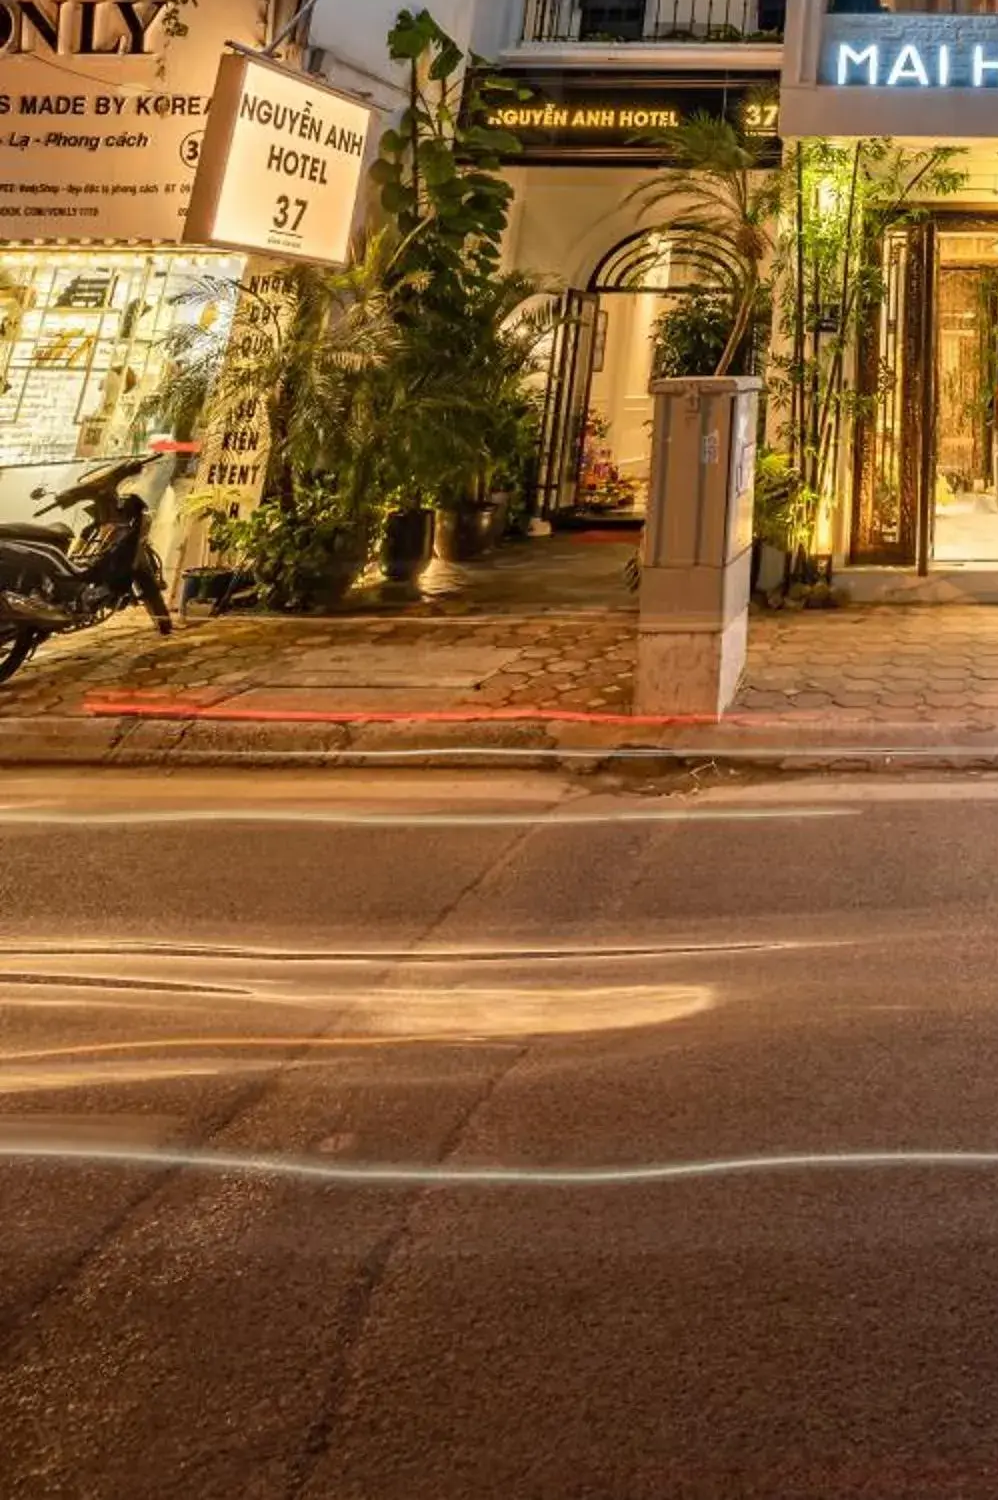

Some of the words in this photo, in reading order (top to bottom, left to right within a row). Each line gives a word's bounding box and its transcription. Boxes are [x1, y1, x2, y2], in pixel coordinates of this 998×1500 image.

[837, 43, 948, 86] MAI
[20, 95, 85, 115] MADE
[95, 96, 127, 115] BY
[746, 104, 778, 127] 37
[240, 93, 323, 143] NGUYỄN
[324, 124, 363, 157] ANH
[572, 108, 615, 127] ANH
[619, 109, 680, 128] HOTEL
[9, 131, 30, 151] Lạ
[45, 131, 100, 152] Phong
[105, 131, 148, 147] cách
[267, 144, 328, 185] HOTEL
[272, 194, 308, 231] 37
[207, 463, 261, 485] EVENT
